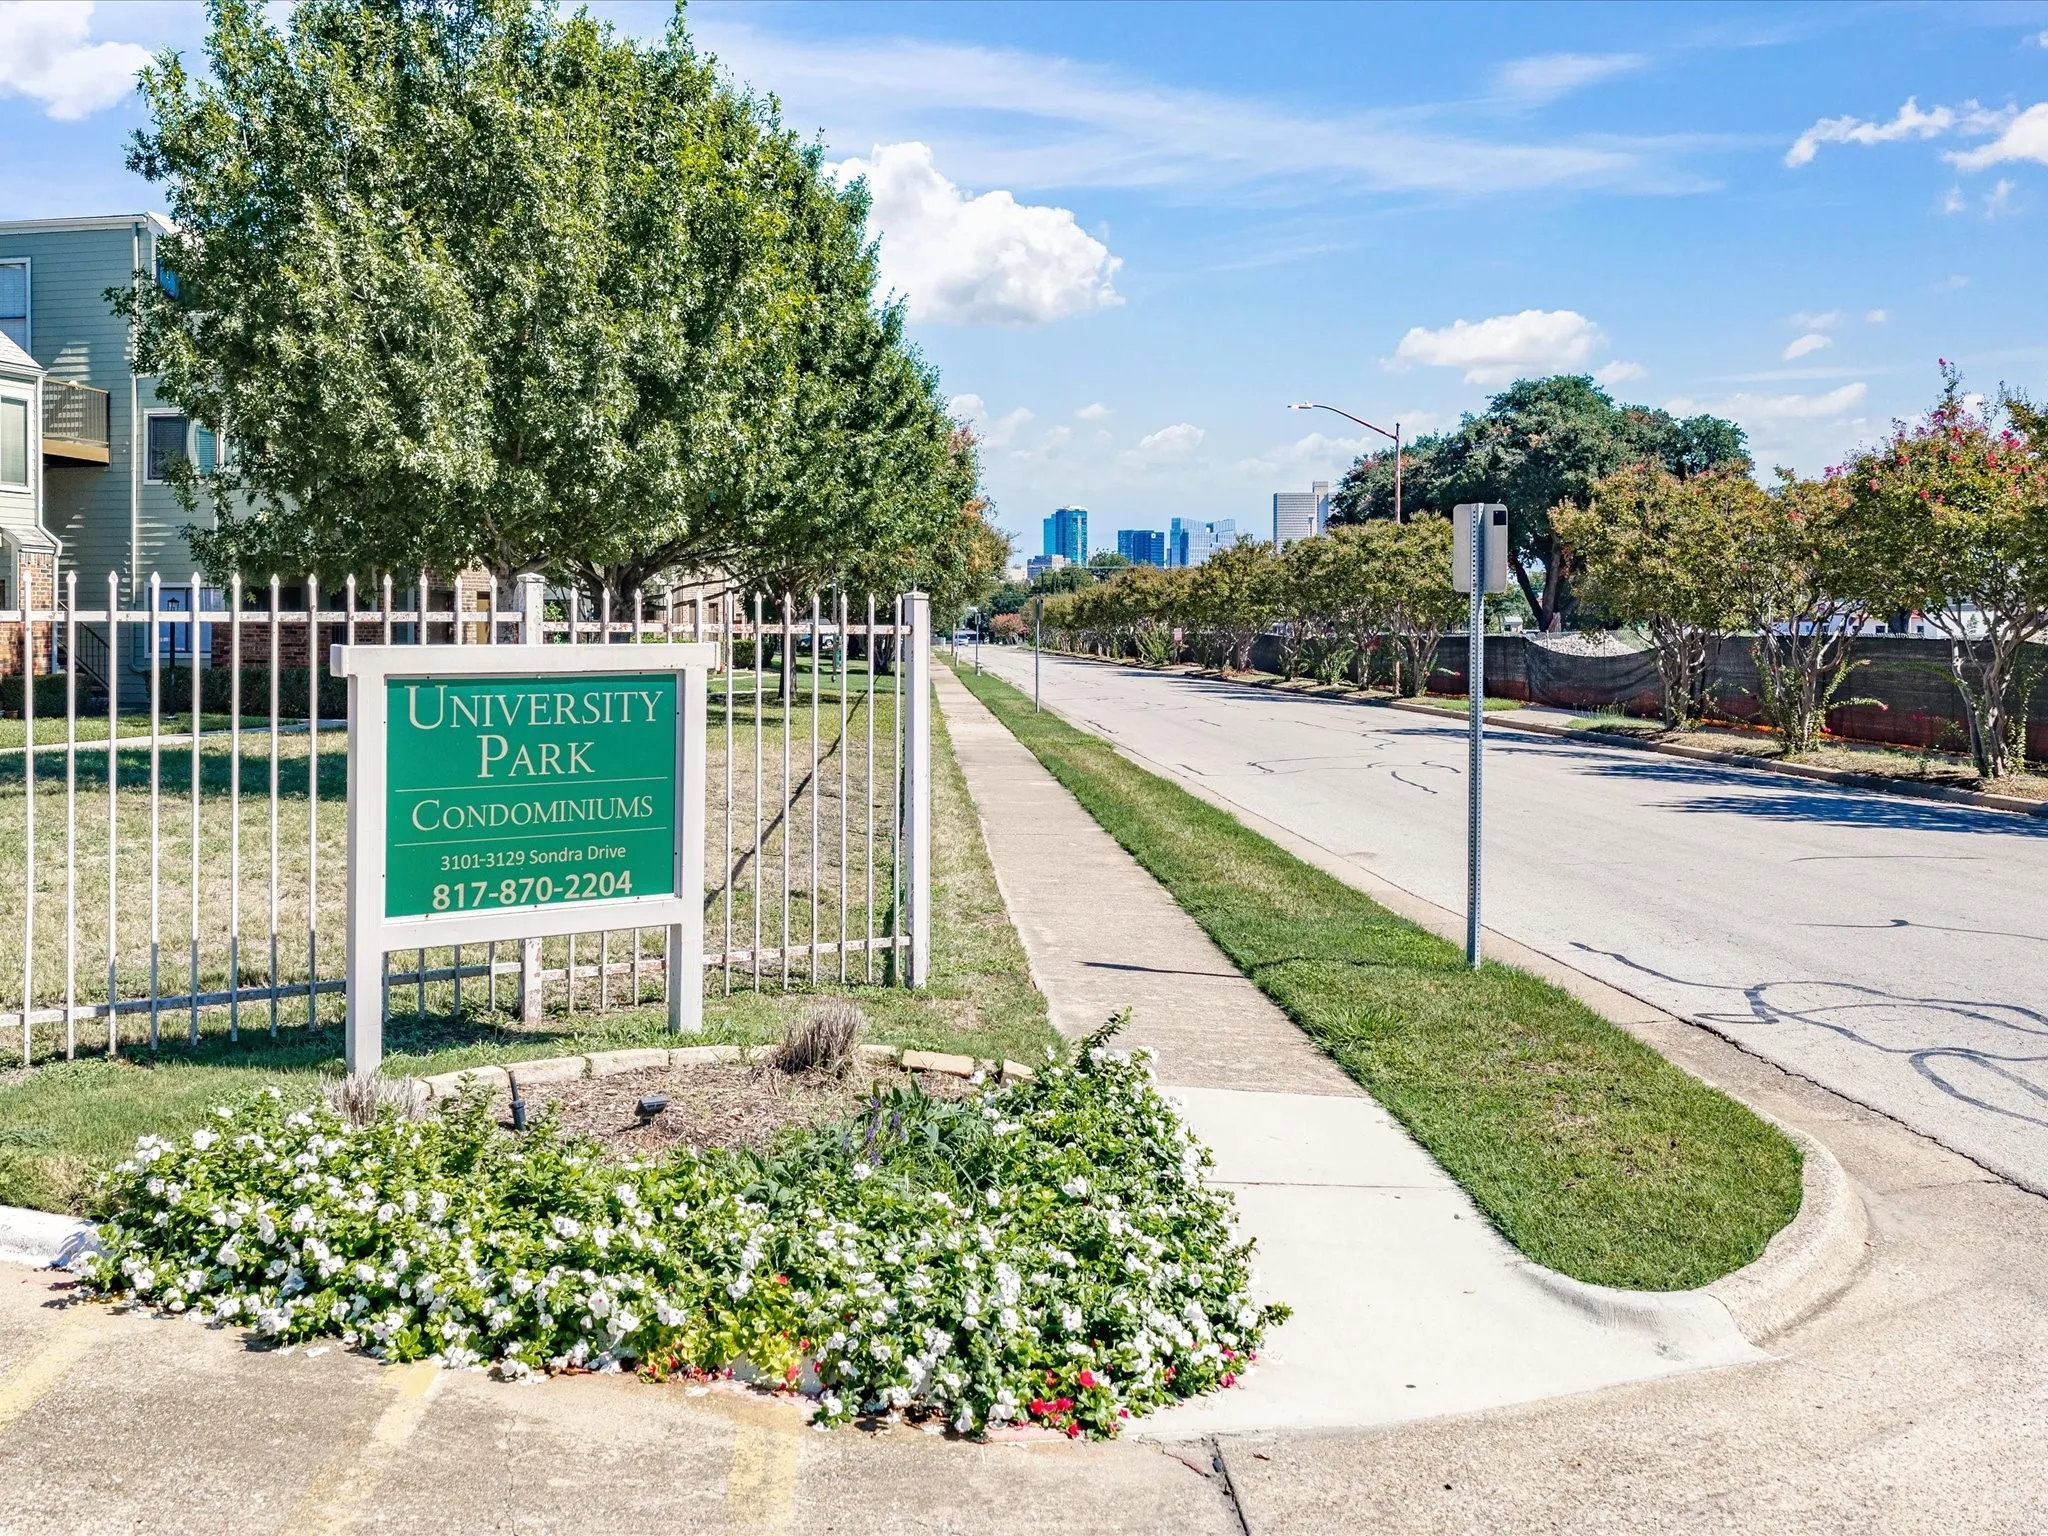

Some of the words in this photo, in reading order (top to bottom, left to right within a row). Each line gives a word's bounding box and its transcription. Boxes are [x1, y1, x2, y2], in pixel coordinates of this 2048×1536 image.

[404, 685, 663, 730] UNIVERSITY
[476, 734, 595, 778] PARK
[412, 795, 653, 832] CONDOMINIUMS
[440, 850, 525, 871] 3101-3129
[529, 847, 583, 865] Sondra
[588, 845, 626, 860] Drive
[432, 870, 632, 910] 817-870-2204
